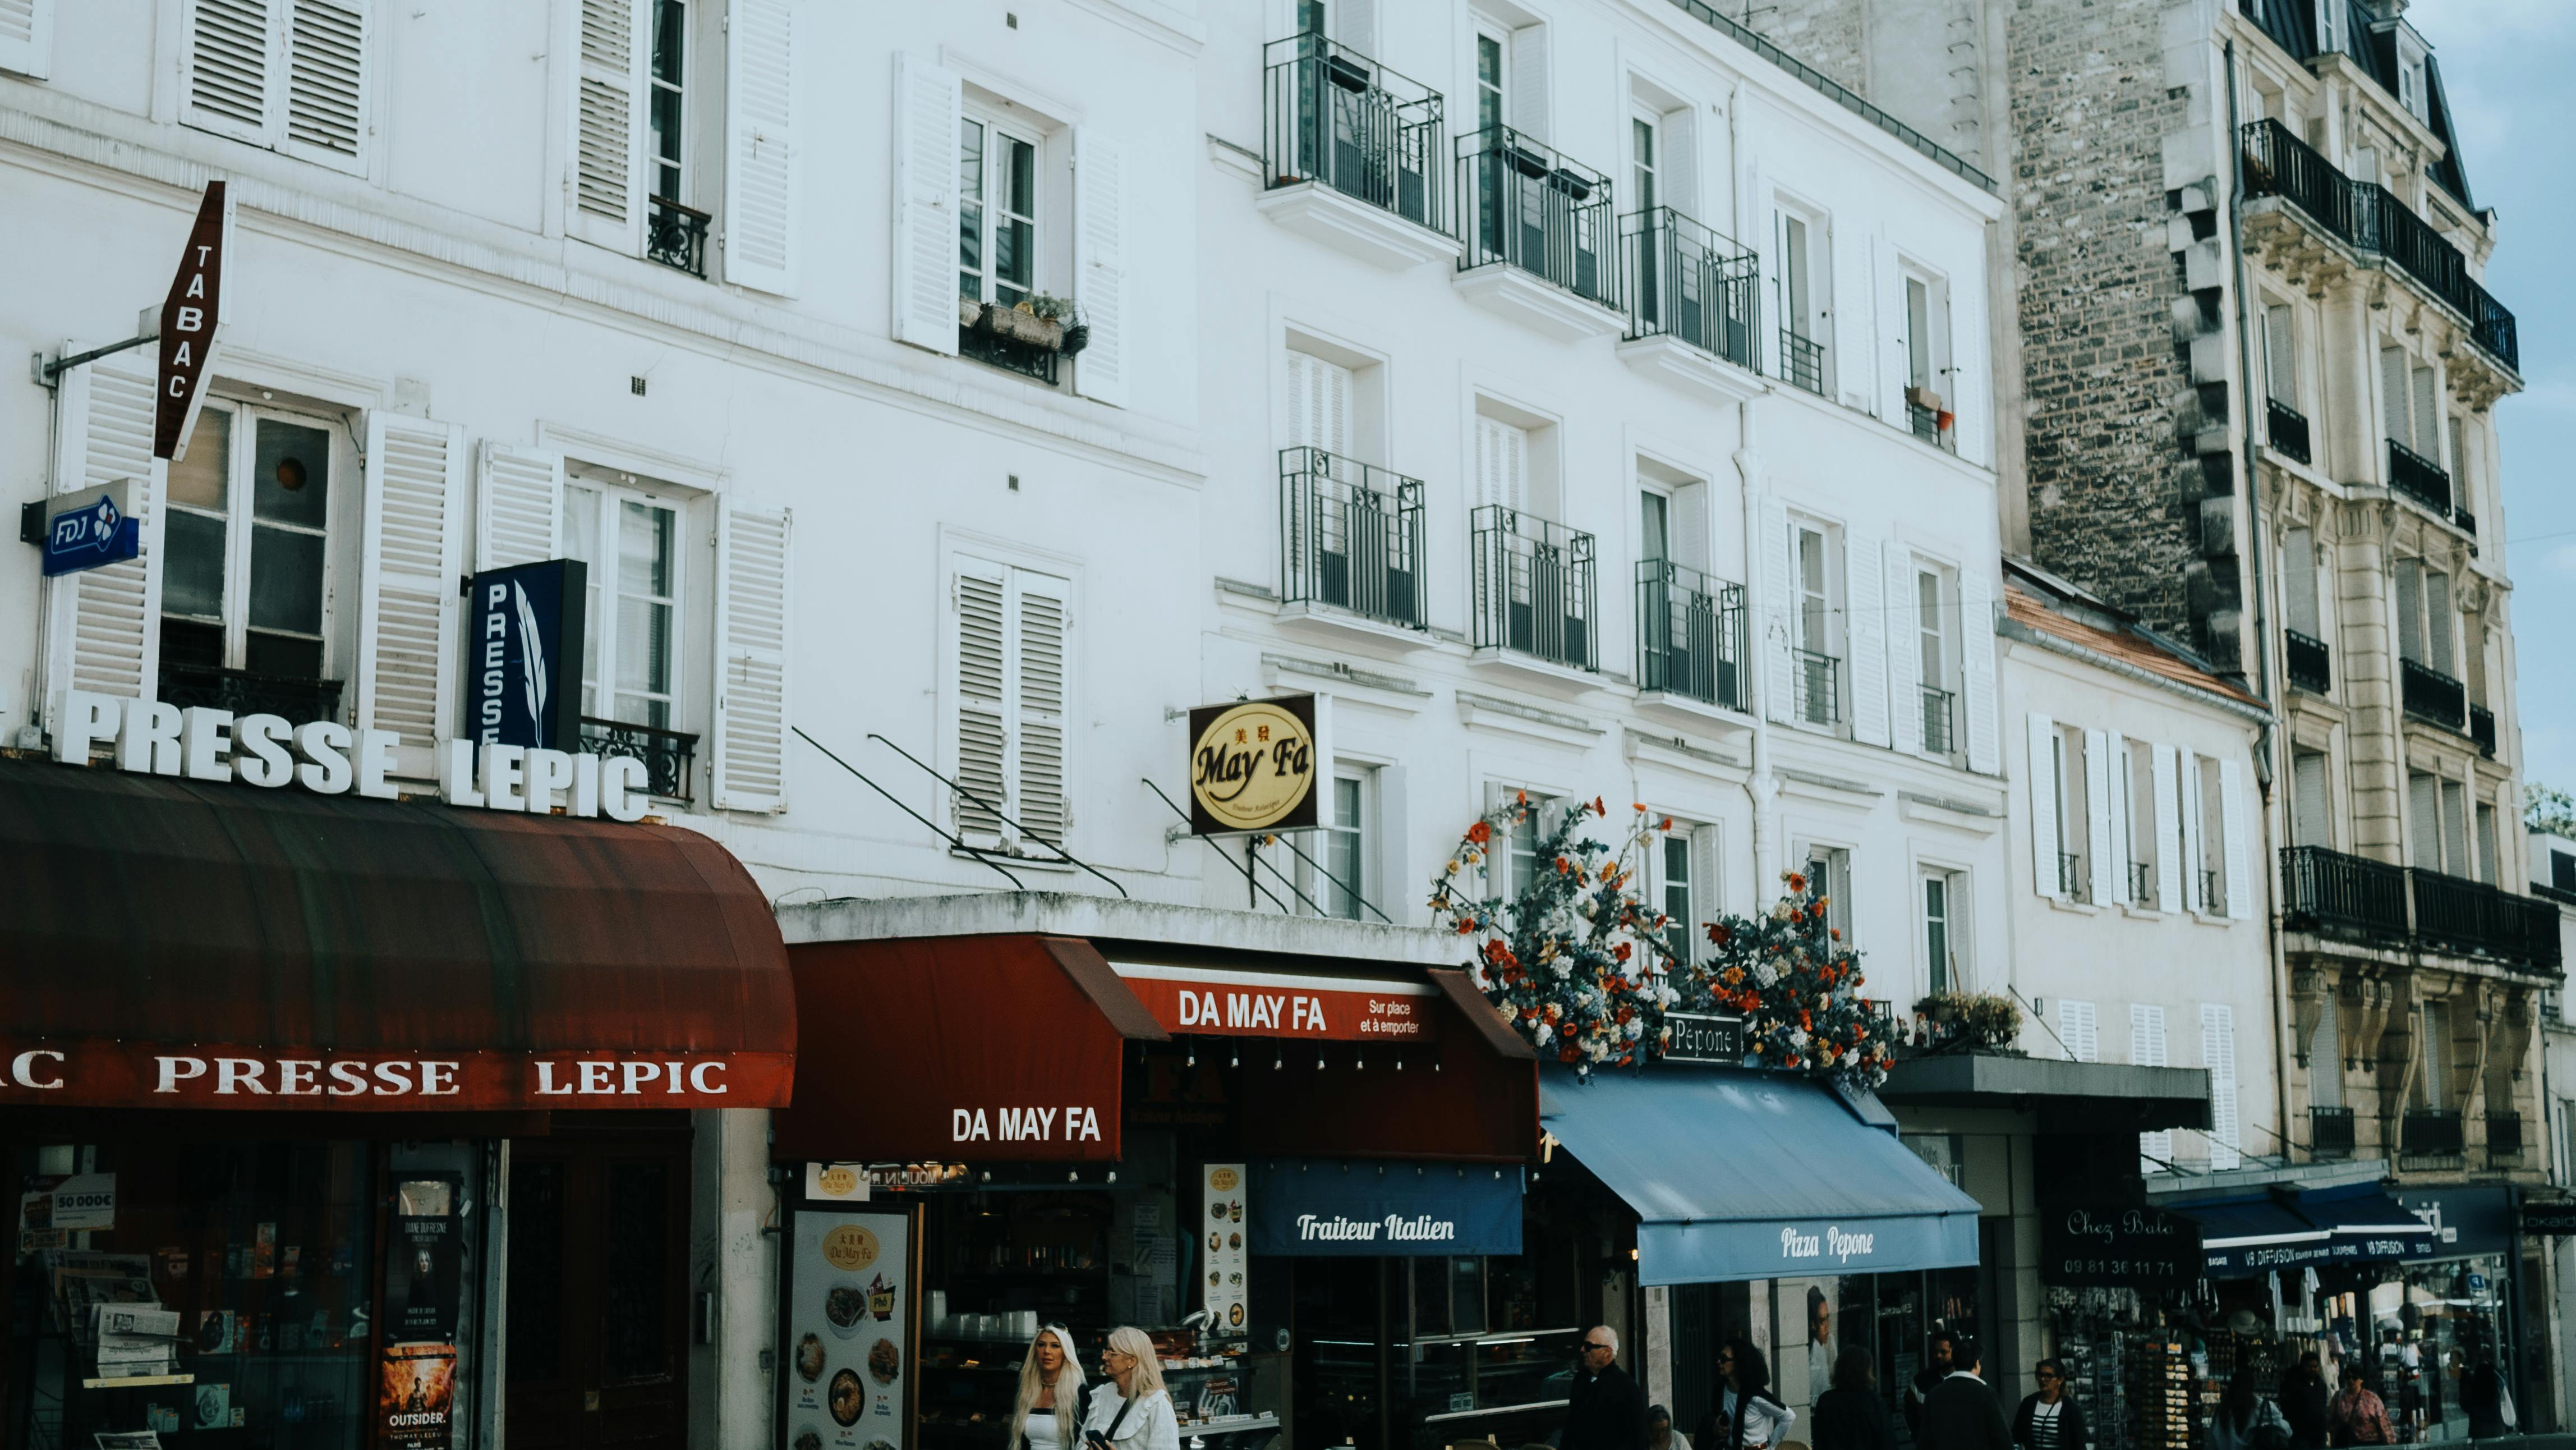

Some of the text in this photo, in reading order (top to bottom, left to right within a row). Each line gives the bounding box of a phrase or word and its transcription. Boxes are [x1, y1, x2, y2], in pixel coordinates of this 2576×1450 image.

[169, 245, 212, 398] TABAC
[56, 516, 88, 545] FDJ
[54, 690, 649, 822] PRESSE LEPIC
[1195, 737, 1309, 802] May Fa
[1179, 990, 1327, 1031] DA MAY FA
[1369, 999, 1411, 1017] Sur place
[1360, 1018, 1419, 1036] et à emporter
[0, 1050, 728, 1096] C PRESSE LEPIC
[953, 1107, 1101, 1141] DA MAY FA
[58, 1196, 74, 1208] 50
[1296, 1214, 1455, 1240] Traiteur Italien
[2067, 1208, 2174, 1245] Chez Bala
[1781, 1226, 1874, 1264] Pizza Pepone
[2258, 1248, 2294, 1265] DIFFUSION
[2064, 1259, 2174, 1275] 09 81 36 11 71
